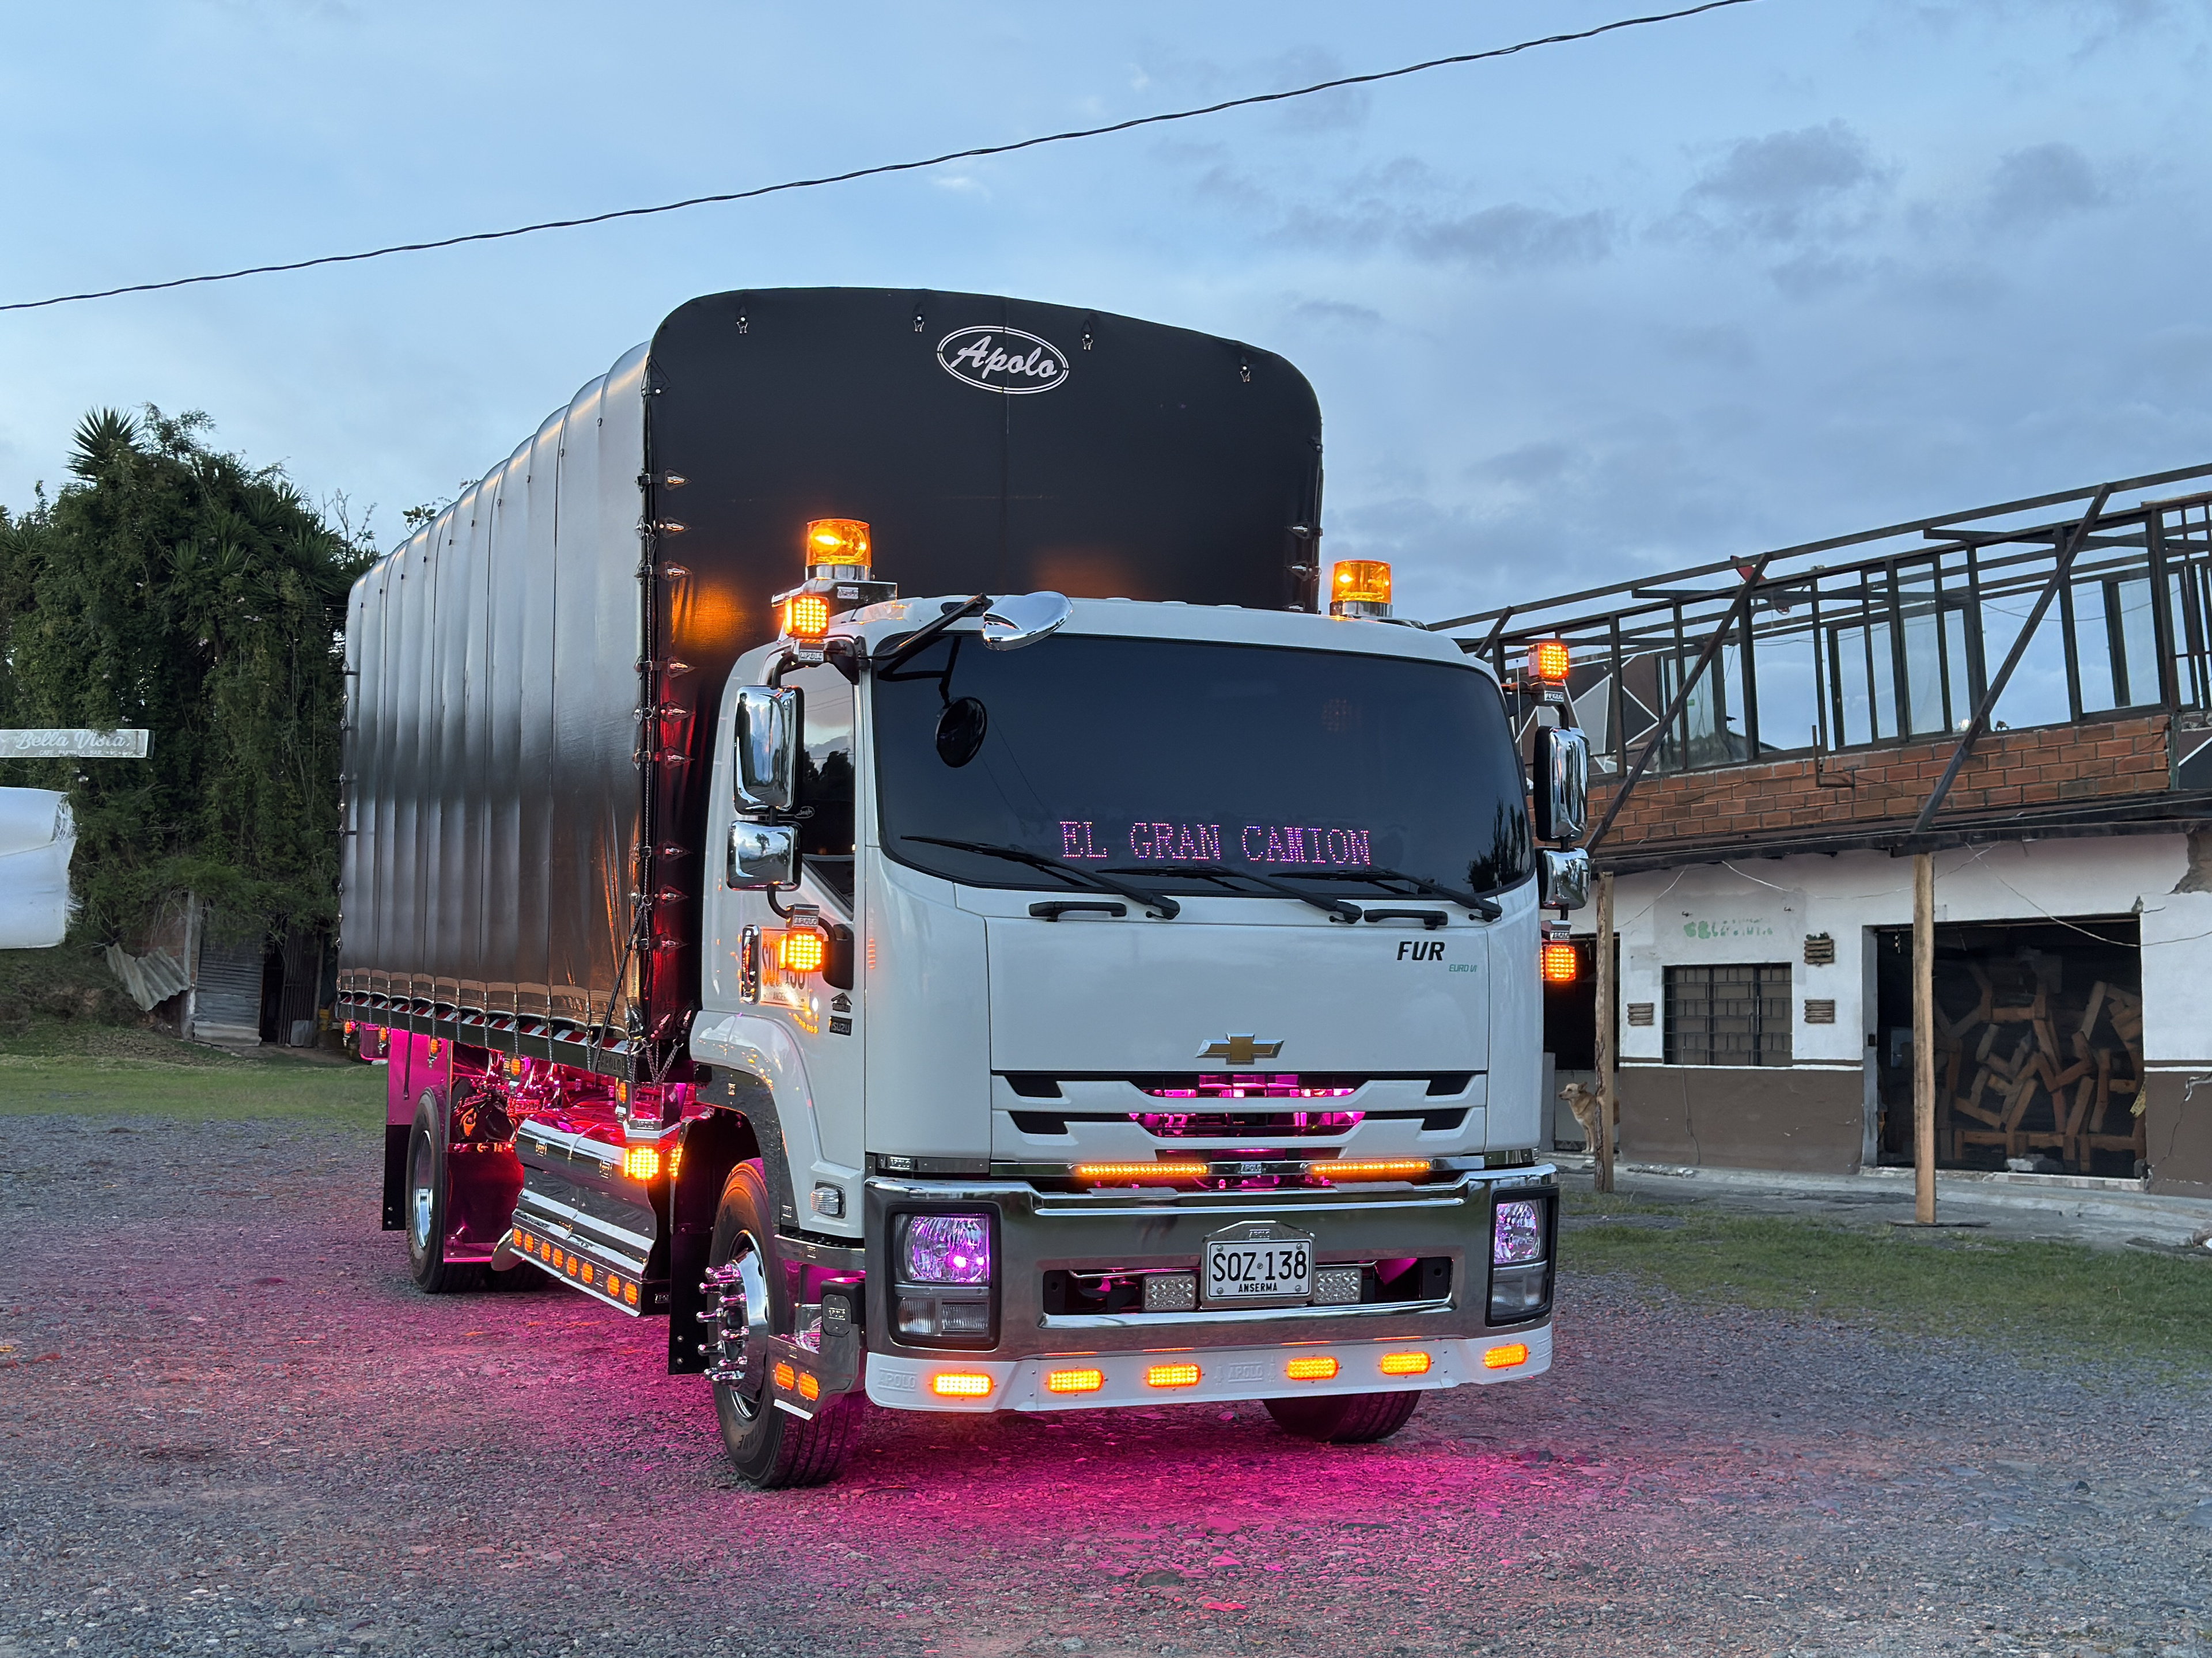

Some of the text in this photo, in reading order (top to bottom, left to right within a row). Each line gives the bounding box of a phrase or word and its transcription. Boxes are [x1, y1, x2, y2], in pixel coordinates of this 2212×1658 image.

[950, 335, 1058, 380] Apolo
[15, 730, 69, 750] Bella
[1059, 821, 1371, 866] EL GRAN CAMION
[1449, 964, 1469, 972] EURO
[1238, 1282, 1278, 1293] ANSERMA
